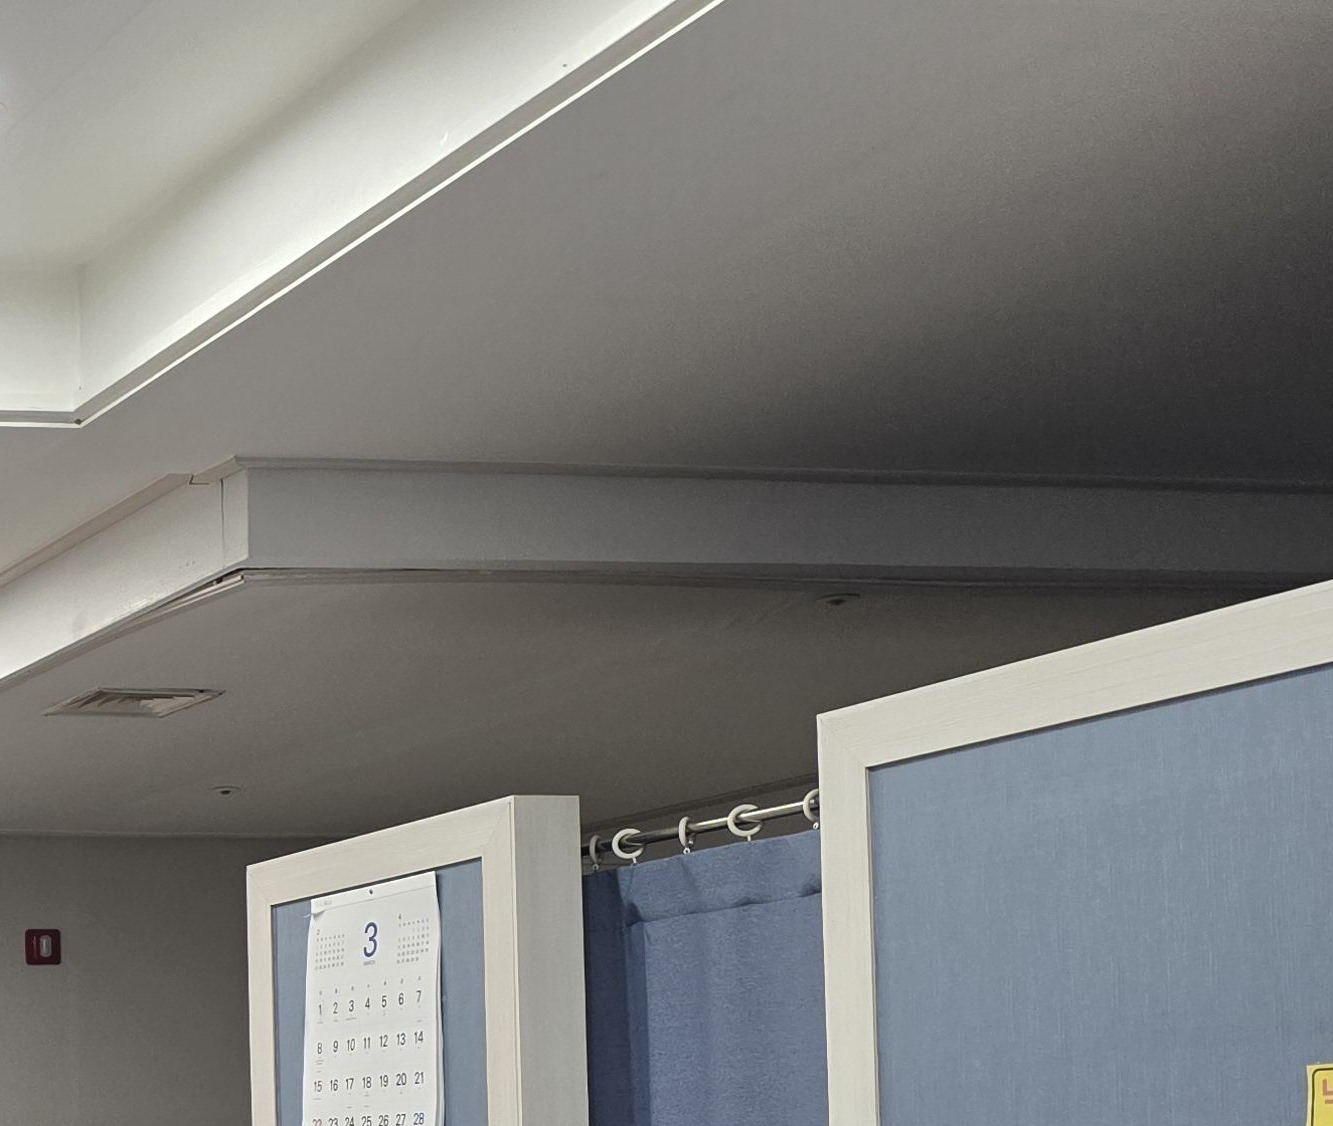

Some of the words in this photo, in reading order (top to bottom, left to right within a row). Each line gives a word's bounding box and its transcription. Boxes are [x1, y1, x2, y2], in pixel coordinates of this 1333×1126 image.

[363, 921, 378, 957] 3
[318, 1004, 322, 1016] 1
[333, 1002, 338, 1014] 2
[349, 1000, 354, 1012] 3
[365, 997, 370, 1009] 4
[381, 995, 387, 1008] 5
[398, 992, 404, 1005] 6
[416, 990, 422, 1003] 7
[317, 1042, 323, 1054] 8
[333, 1040, 338, 1053] 9
[347, 1038, 355, 1051] 10
[363, 1037, 371, 1049] 11
[379, 1034, 388, 1048] 12
[396, 1032, 406, 1046] 13
[414, 1030, 424, 1044] 14
[313, 1080, 322, 1093] 15
[330, 1079, 338, 1092] 16
[345, 1077, 354, 1090] 17
[362, 1076, 372, 1089] 18
[379, 1074, 389, 1087] 19
[396, 1072, 407, 1086] 20
[414, 1071, 424, 1085] 21
[378, 1115, 389, 1126] 26
[396, 1113, 406, 1126] 27
[413, 1112, 424, 1125] 28
